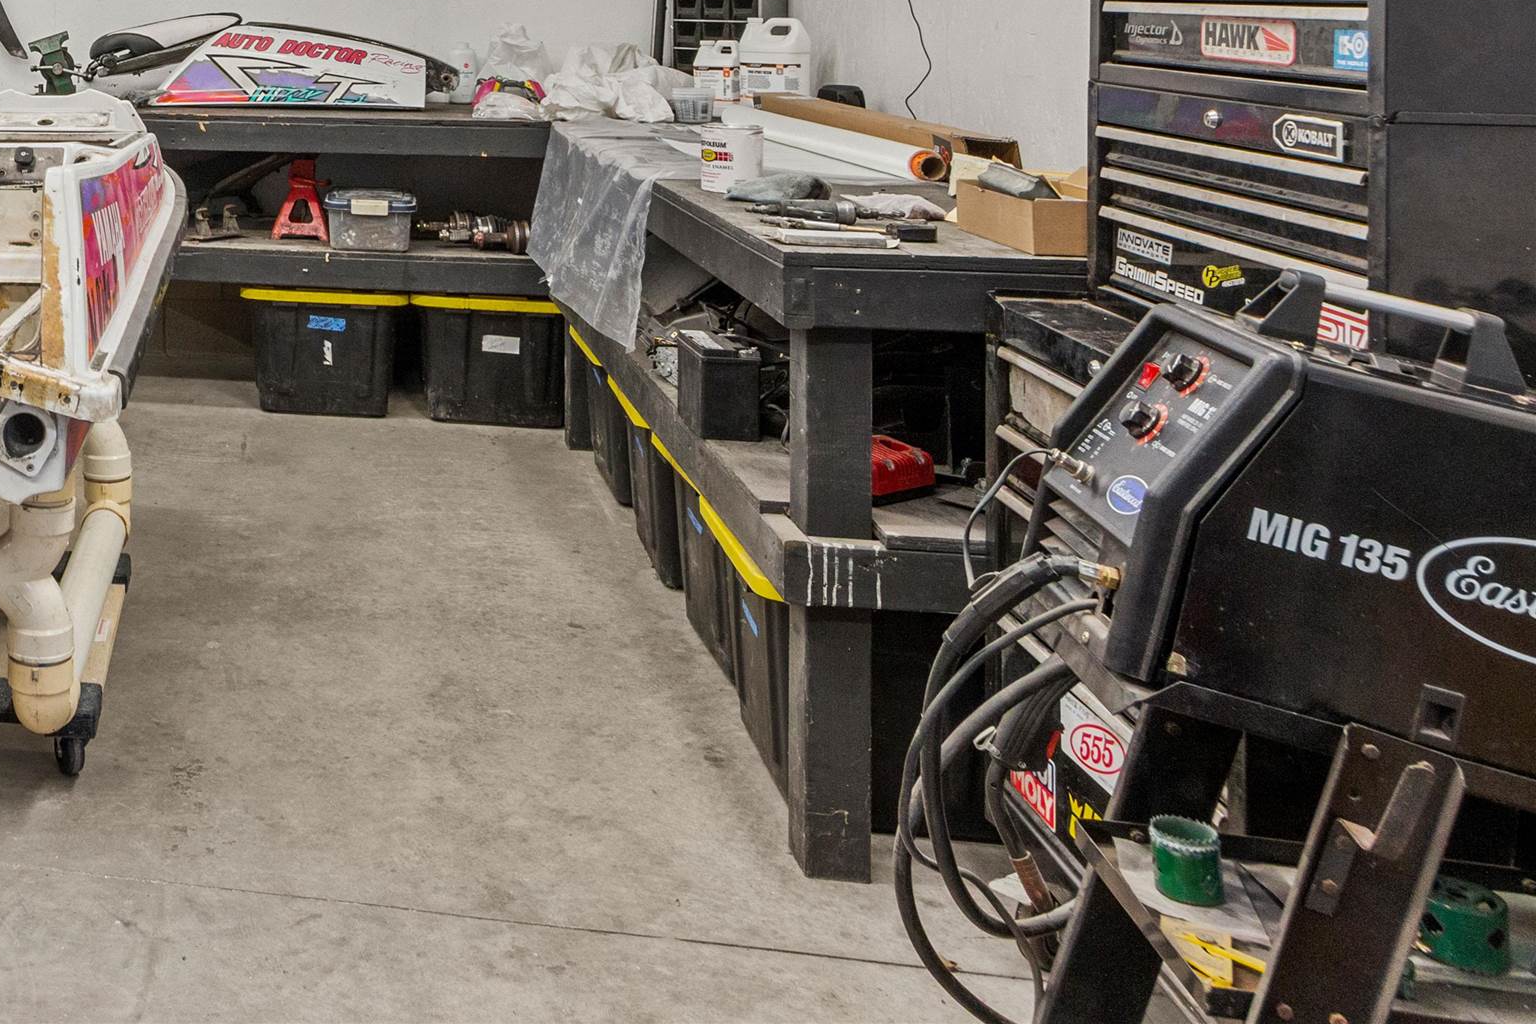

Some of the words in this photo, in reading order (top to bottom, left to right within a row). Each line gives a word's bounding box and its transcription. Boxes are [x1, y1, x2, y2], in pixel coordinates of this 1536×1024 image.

[1124, 22, 1169, 37] Injector
[1205, 22, 1260, 51] HAWK
[212, 33, 275, 52] AUTO
[278, 40, 368, 65] DOCTOR
[1297, 126, 1336, 147] KOBALT
[1119, 231, 1170, 256] INNOVATE
[1246, 507, 1331, 560] MIG
[1339, 533, 1411, 581] 135
[1080, 732, 1114, 768] 555
[1011, 771, 1054, 824] MOLY
